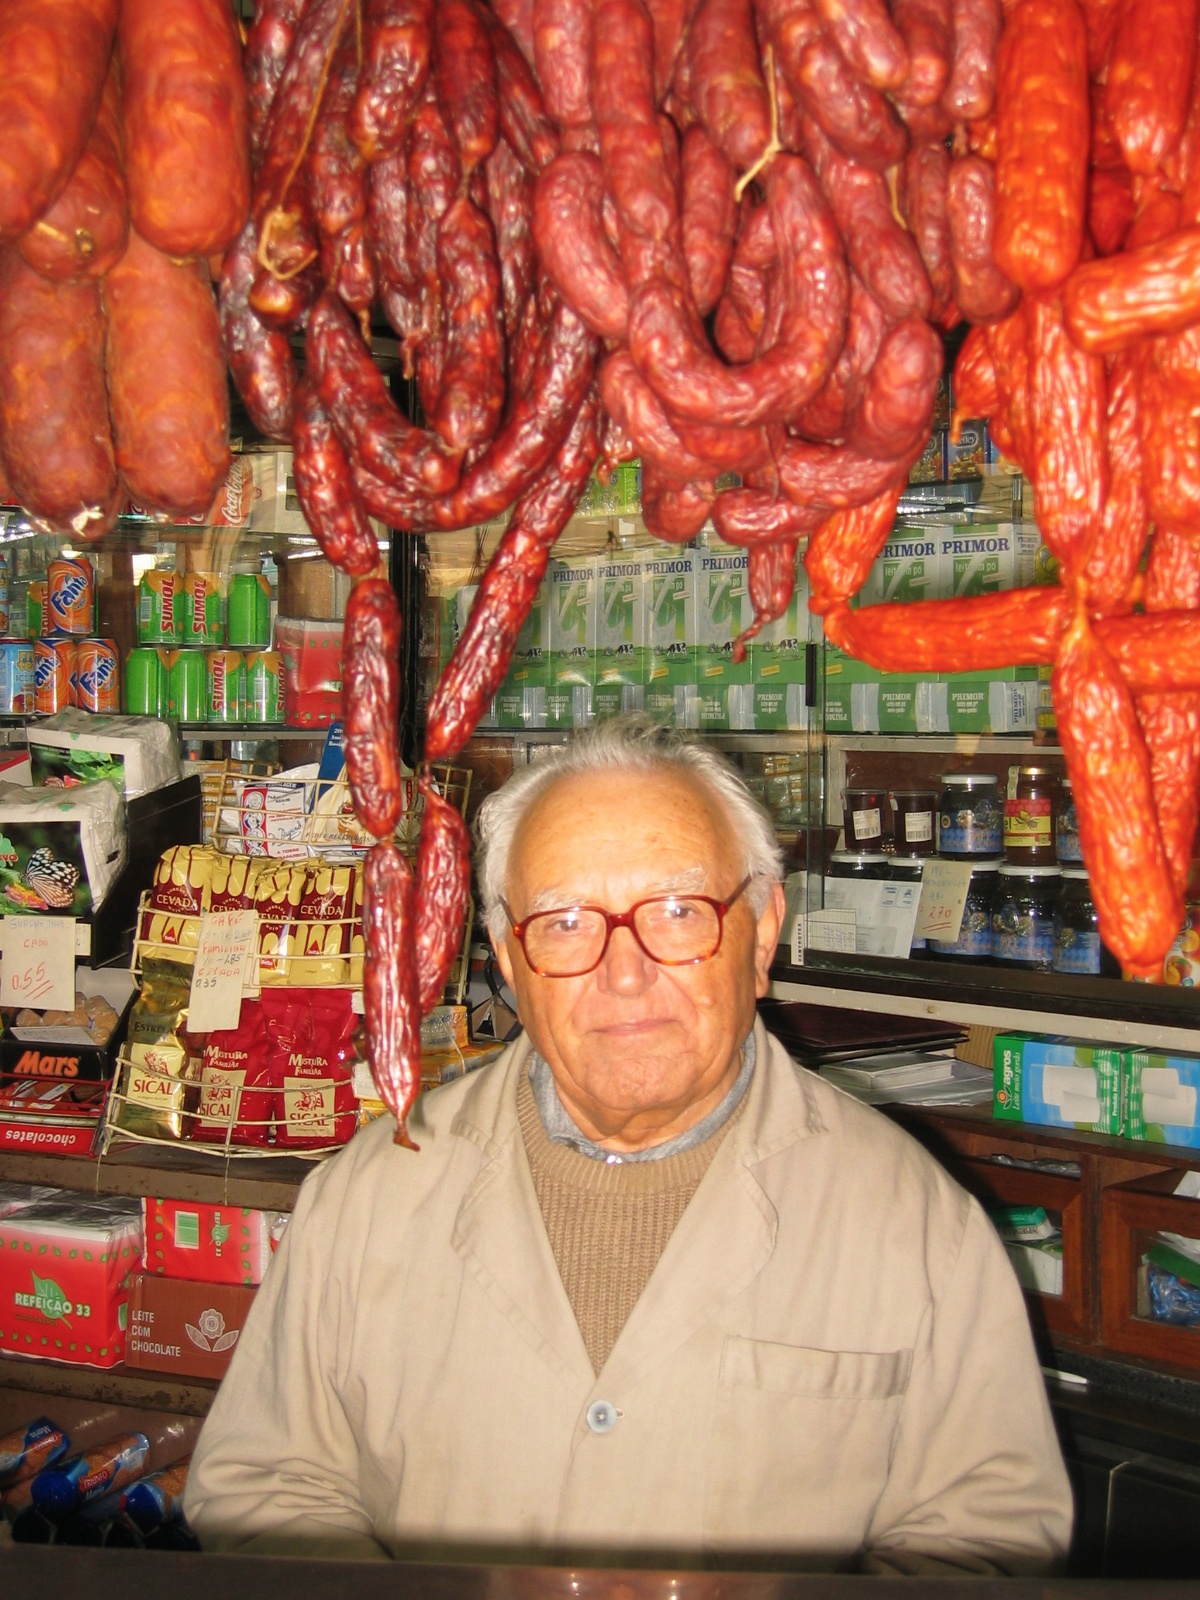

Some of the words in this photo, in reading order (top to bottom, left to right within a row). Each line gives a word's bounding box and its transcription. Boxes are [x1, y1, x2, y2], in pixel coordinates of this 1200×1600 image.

[957, 434, 976, 446] etley
[878, 543, 936, 558] RIMOR
[942, 538, 1010, 555] PRIMOR
[599, 564, 642, 578] PRIMOR
[645, 561, 692, 574] PRIMOR
[702, 557, 749, 570] PRIMOR
[553, 568, 594, 582] PRIMOR
[51, 576, 87, 617] Fanta
[160, 576, 175, 636] SUMOL
[192, 578, 208, 638] SUMOL
[34, 656, 60, 688] anta
[79, 656, 117, 697] Fanta
[212, 655, 226, 712] SUMOL
[757, 693, 783, 701] PRIMOR
[882, 693, 912, 701] PRIMOR
[952, 692, 984, 700] PRIMOR
[156, 894, 199, 911] CEVADA
[300, 905, 343, 916] CEVADA
[258, 912, 296, 924] EVADA
[13, 1050, 79, 1077] Mars
[1003, 1050, 1013, 1086] agros
[1013, 1052, 1022, 1074] gordo
[132, 1079, 174, 1096] SICAL
[1013, 1074, 1021, 1093] meio
[200, 1103, 232, 1117] SICAL
[1012, 1092, 1021, 1111] Leite
[289, 1113, 330, 1127] SICAL
[5, 1130, 77, 1147] chocolates
[14, 1291, 73, 1315] REFEIÇÃO
[76, 1303, 91, 1317] 33
[131, 1310, 155, 1323] LEITE
[131, 1325, 151, 1338] COM
[131, 1340, 181, 1357] CHOCOLATE
[83, 1470, 108, 1489] TRIUNFO
